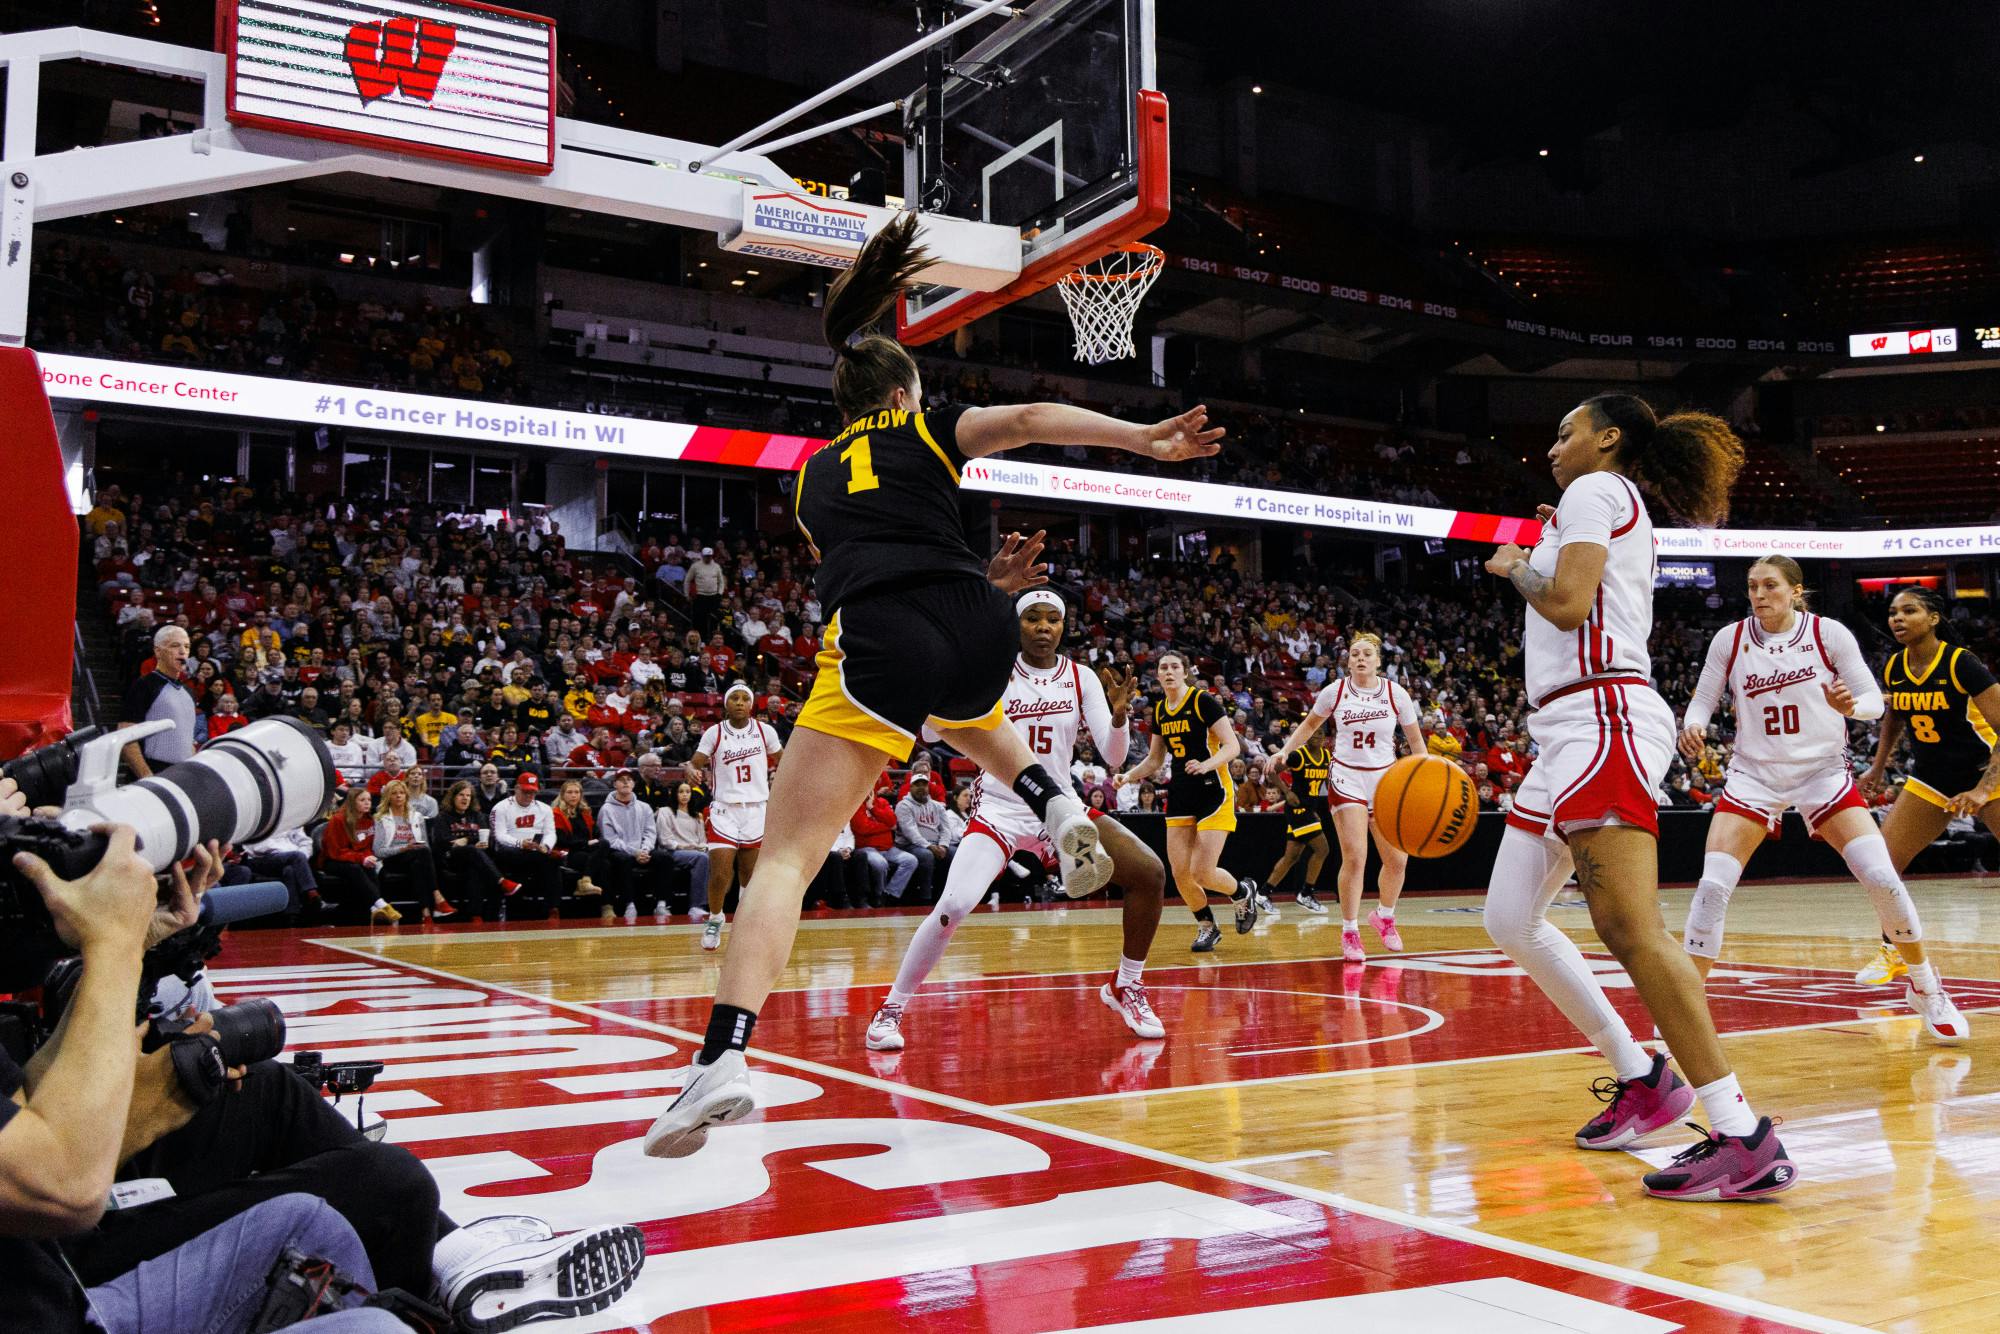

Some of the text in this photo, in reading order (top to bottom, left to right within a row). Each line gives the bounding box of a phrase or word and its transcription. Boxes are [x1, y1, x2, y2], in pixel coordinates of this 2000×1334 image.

[755, 203, 866, 231] AMERICAN FAMILY
[763, 218, 858, 240] INSURANCE
[744, 244, 820, 259] AMERICAN
[1182, 257, 1457, 319] 1941 1947 2000 2005 2014 2015
[1506, 319, 1835, 352] MEN'S FINAL FOUR 1941 2000 2014 2015
[1936, 335, 1952, 346] 16
[100, 374, 168, 395] Cancer
[174, 382, 238, 402] Center
[315, 395, 625, 444] #1 Cancer Hospital in WI
[840, 434, 880, 494] 1
[1063, 478, 1111, 495] Carbone
[1114, 484, 1153, 499] Cancer
[1155, 487, 1192, 503] Center
[1234, 495, 1414, 527] #1 Cancer Hospital in WI
[1654, 536, 1843, 551] Health Carbone Cancer Center
[1883, 538, 1904, 550] #1
[1908, 535, 1971, 550] Cancer
[1661, 567, 1708, 576] NICHOLAS
[1743, 665, 1817, 699] Badgers
[1004, 697, 1074, 723] Badgers
[1893, 691, 1950, 711] IOWA
[1161, 719, 1191, 736] IOWA
[1342, 708, 1389, 726] Badgers
[1763, 704, 1801, 736] 20
[1910, 714, 1941, 743] 8
[1028, 725, 1053, 754] 15
[1168, 736, 1186, 758] 5
[1353, 731, 1376, 749] 24
[722, 746, 762, 765] Badgers
[735, 764, 751, 784] 13
[1438, 780, 1469, 844] Wilson
